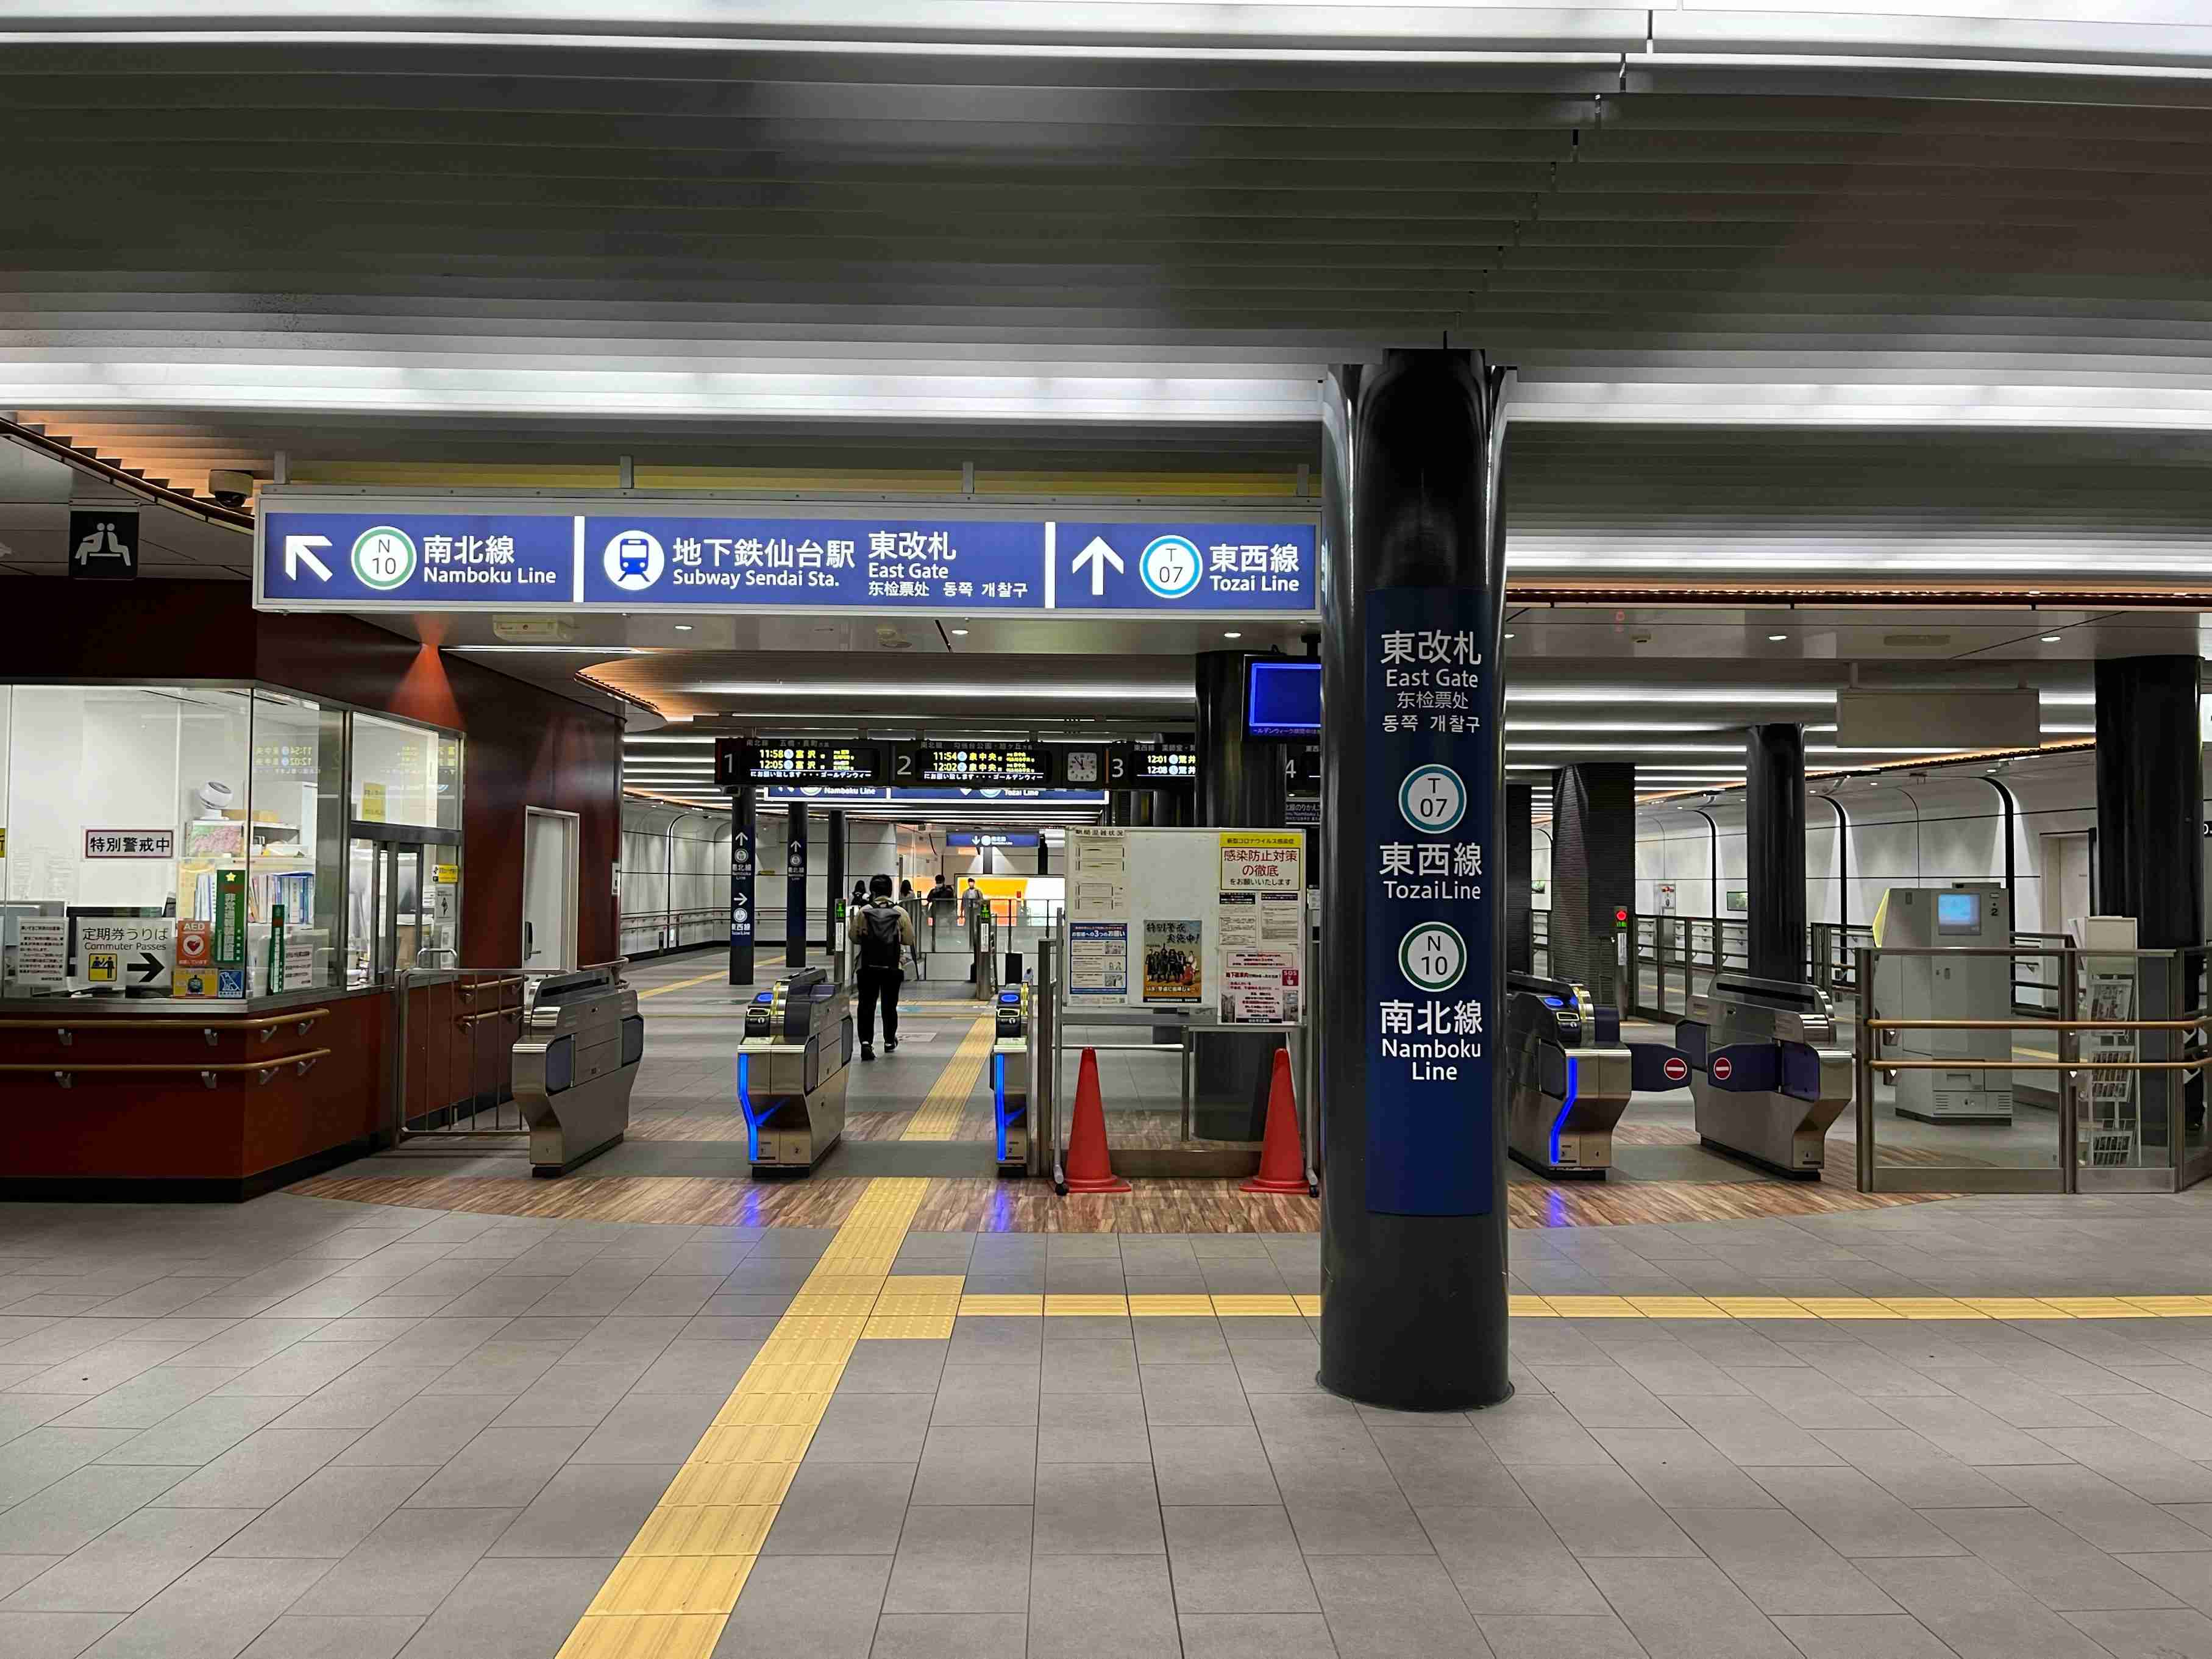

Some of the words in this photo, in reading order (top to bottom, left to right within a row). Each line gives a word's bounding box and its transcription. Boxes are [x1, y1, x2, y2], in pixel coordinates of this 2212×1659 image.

[377, 539, 391, 553] N
[422, 535, 515, 564] 南北線
[672, 536, 855, 569] 地下鉄仙台駅
[868, 530, 957, 561] 東改札
[1165, 547, 1177, 562] T
[371, 557, 397, 575] 10
[1209, 542, 1300, 573] 東西線
[424, 566, 512, 584] Namboku
[517, 568, 557, 584] Line
[672, 569, 741, 589] Subway
[745, 570, 803, 586] Sendai
[808, 571, 839, 587] Sta.
[869, 562, 905, 578] East
[908, 563, 949, 579] Gate
[1159, 566, 1183, 583] 07
[868, 581, 930, 597] 东检票处
[943, 581, 973, 597] 동쪽
[981, 582, 1028, 598] 개찰구
[1209, 575, 1256, 592] Tozai
[1261, 575, 1300, 592] Line
[1380, 629, 1482, 666] 東改札
[1385, 669, 1429, 687] East
[1435, 668, 1478, 688] Gate
[1396, 691, 1469, 710] 东检票处
[1382, 715, 1419, 733] 동쪽
[1429, 714, 1481, 733] 개찰구
[724, 753, 733, 773] 1
[759, 749, 784, 759] 11:58
[933, 751, 957, 761] 11:54
[1147, 755, 1167, 764] 12:01
[759, 760, 784, 770] 12:05
[896, 755, 912, 775] 2
[933, 762, 957, 772] 12:02
[1111, 758, 1124, 778] 3
[1286, 759, 1296, 778] 4
[1428, 778, 1441, 794] T
[1420, 798, 1448, 818] 07
[90, 837, 170, 853] 特別警戒中
[1223, 850, 1298, 862] 感染防止対策
[1379, 842, 1483, 877] 東西線
[1242, 864, 1279, 877] の徹底
[82, 927, 169, 941] 定期券うりば
[183, 922, 205, 931] AED
[84, 942, 133, 951] Commuter
[136, 942, 167, 951] Passes
[1427, 936, 1441, 951] N
[1421, 956, 1448, 976] 10
[1379, 999, 1483, 1036] 南北線
[1381, 1039, 1481, 1058] Namboku
[1412, 1061, 1458, 1081] Line
